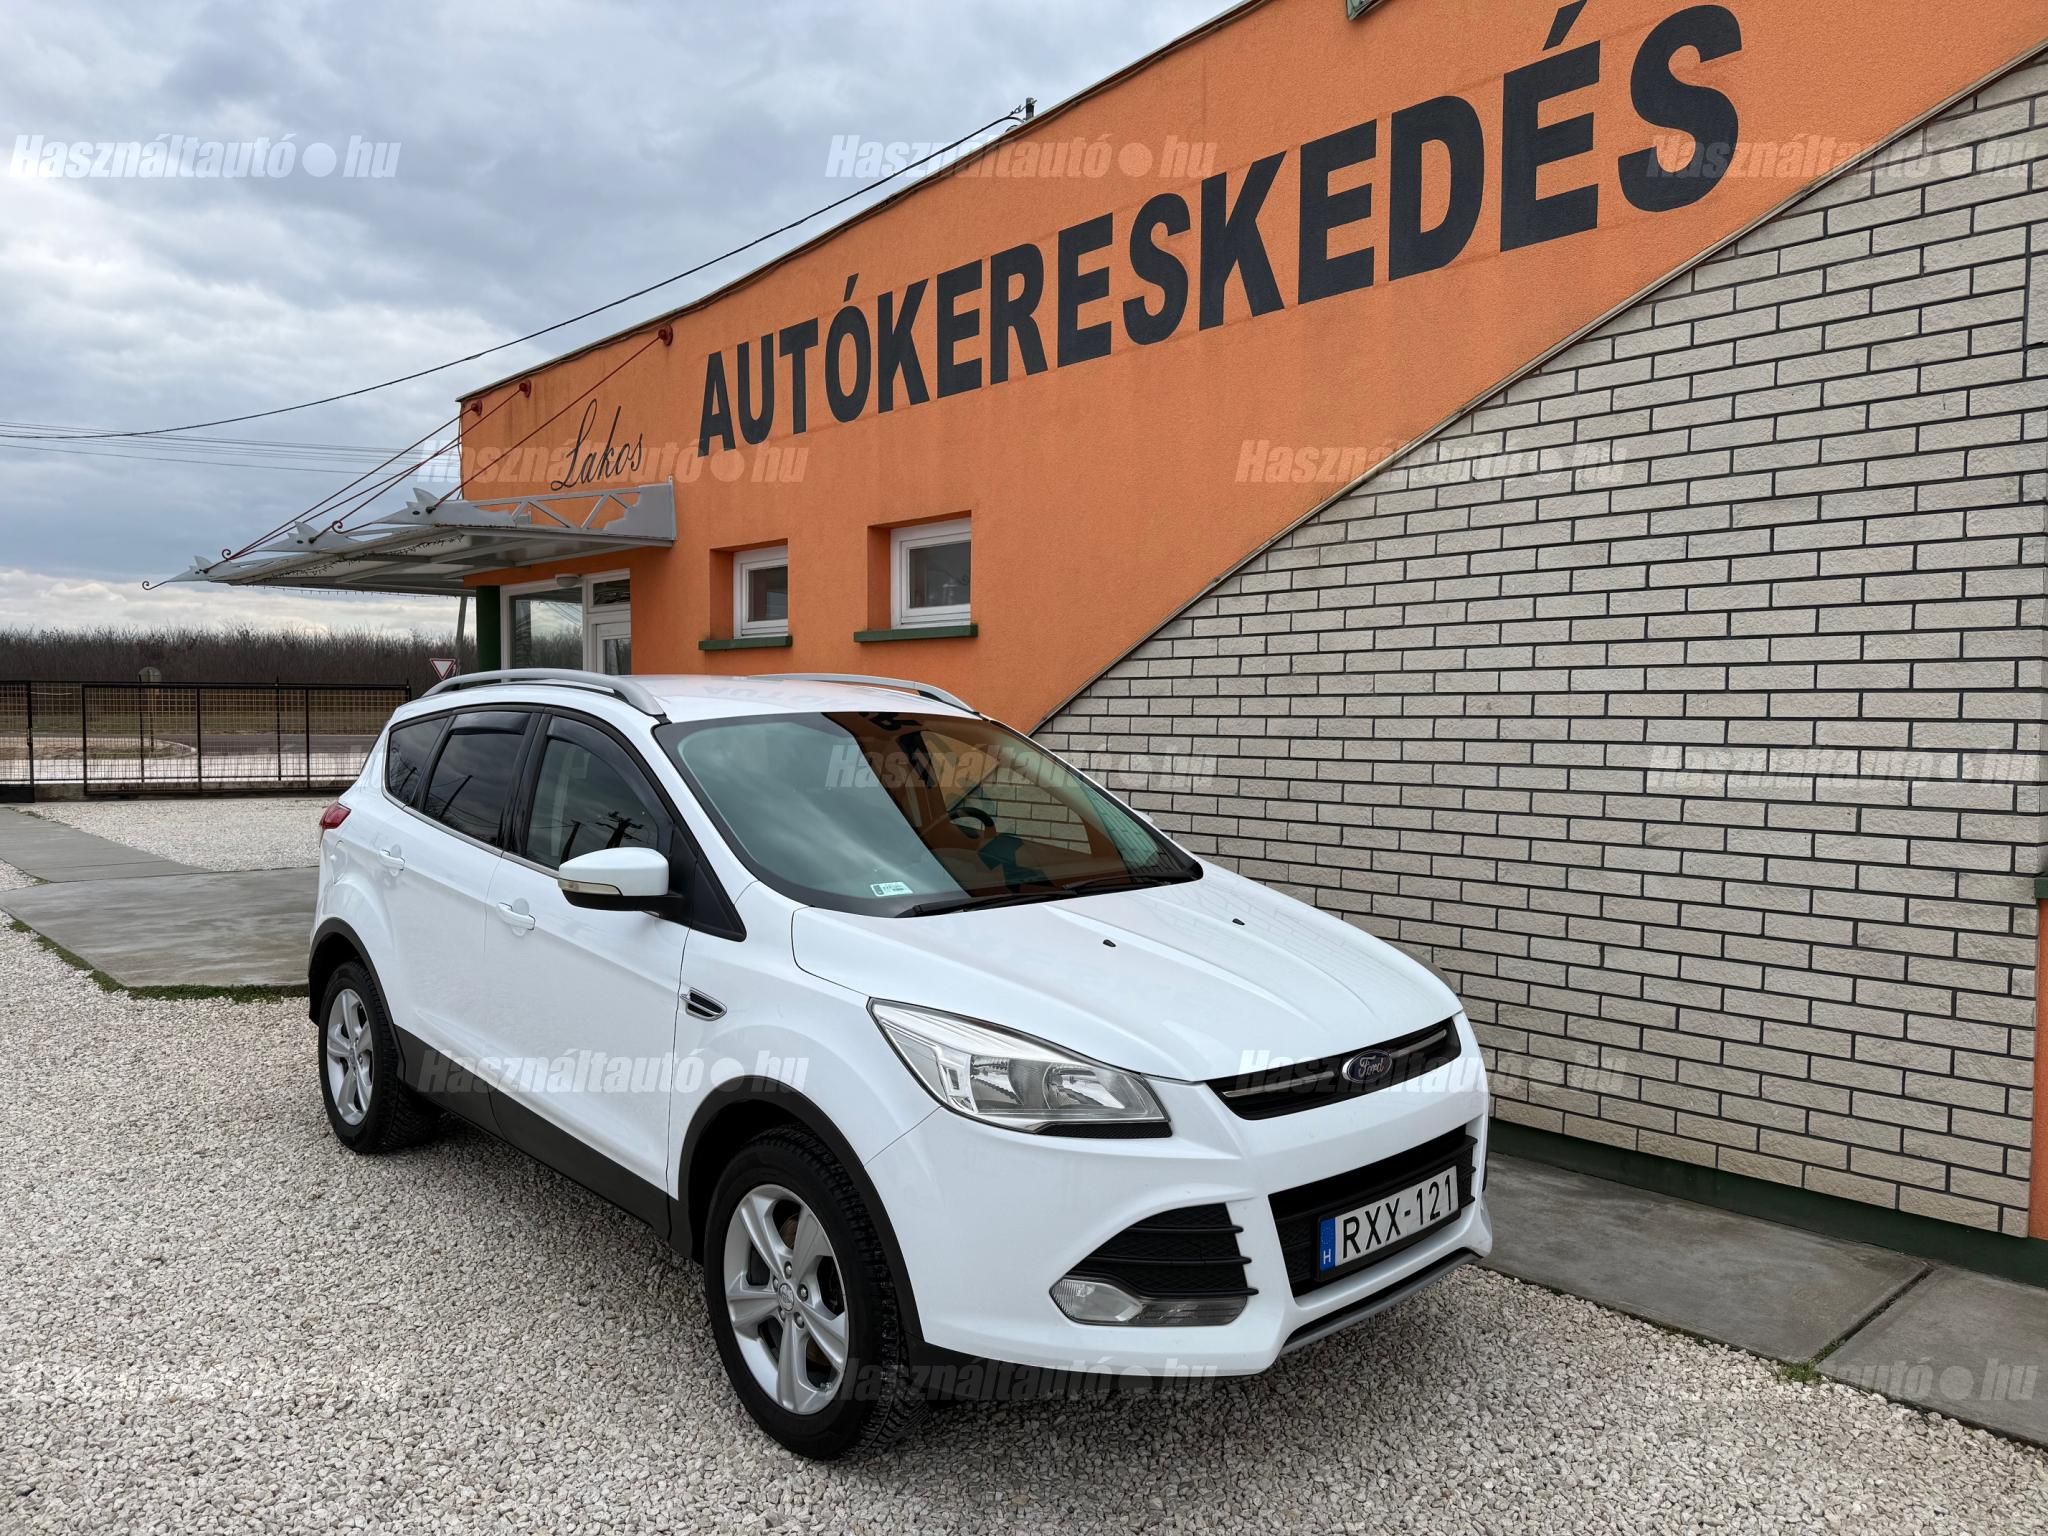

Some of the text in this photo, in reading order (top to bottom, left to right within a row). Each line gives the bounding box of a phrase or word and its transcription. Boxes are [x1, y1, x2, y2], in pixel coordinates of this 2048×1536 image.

[698, 0, 1743, 458] AUTÓKERESKEDÉS
[550, 398, 643, 491] Lakos
[1358, 1055, 1385, 1078] Ford
[1322, 1248, 1332, 1265] H
[1342, 1174, 1452, 1259] RXX-121
